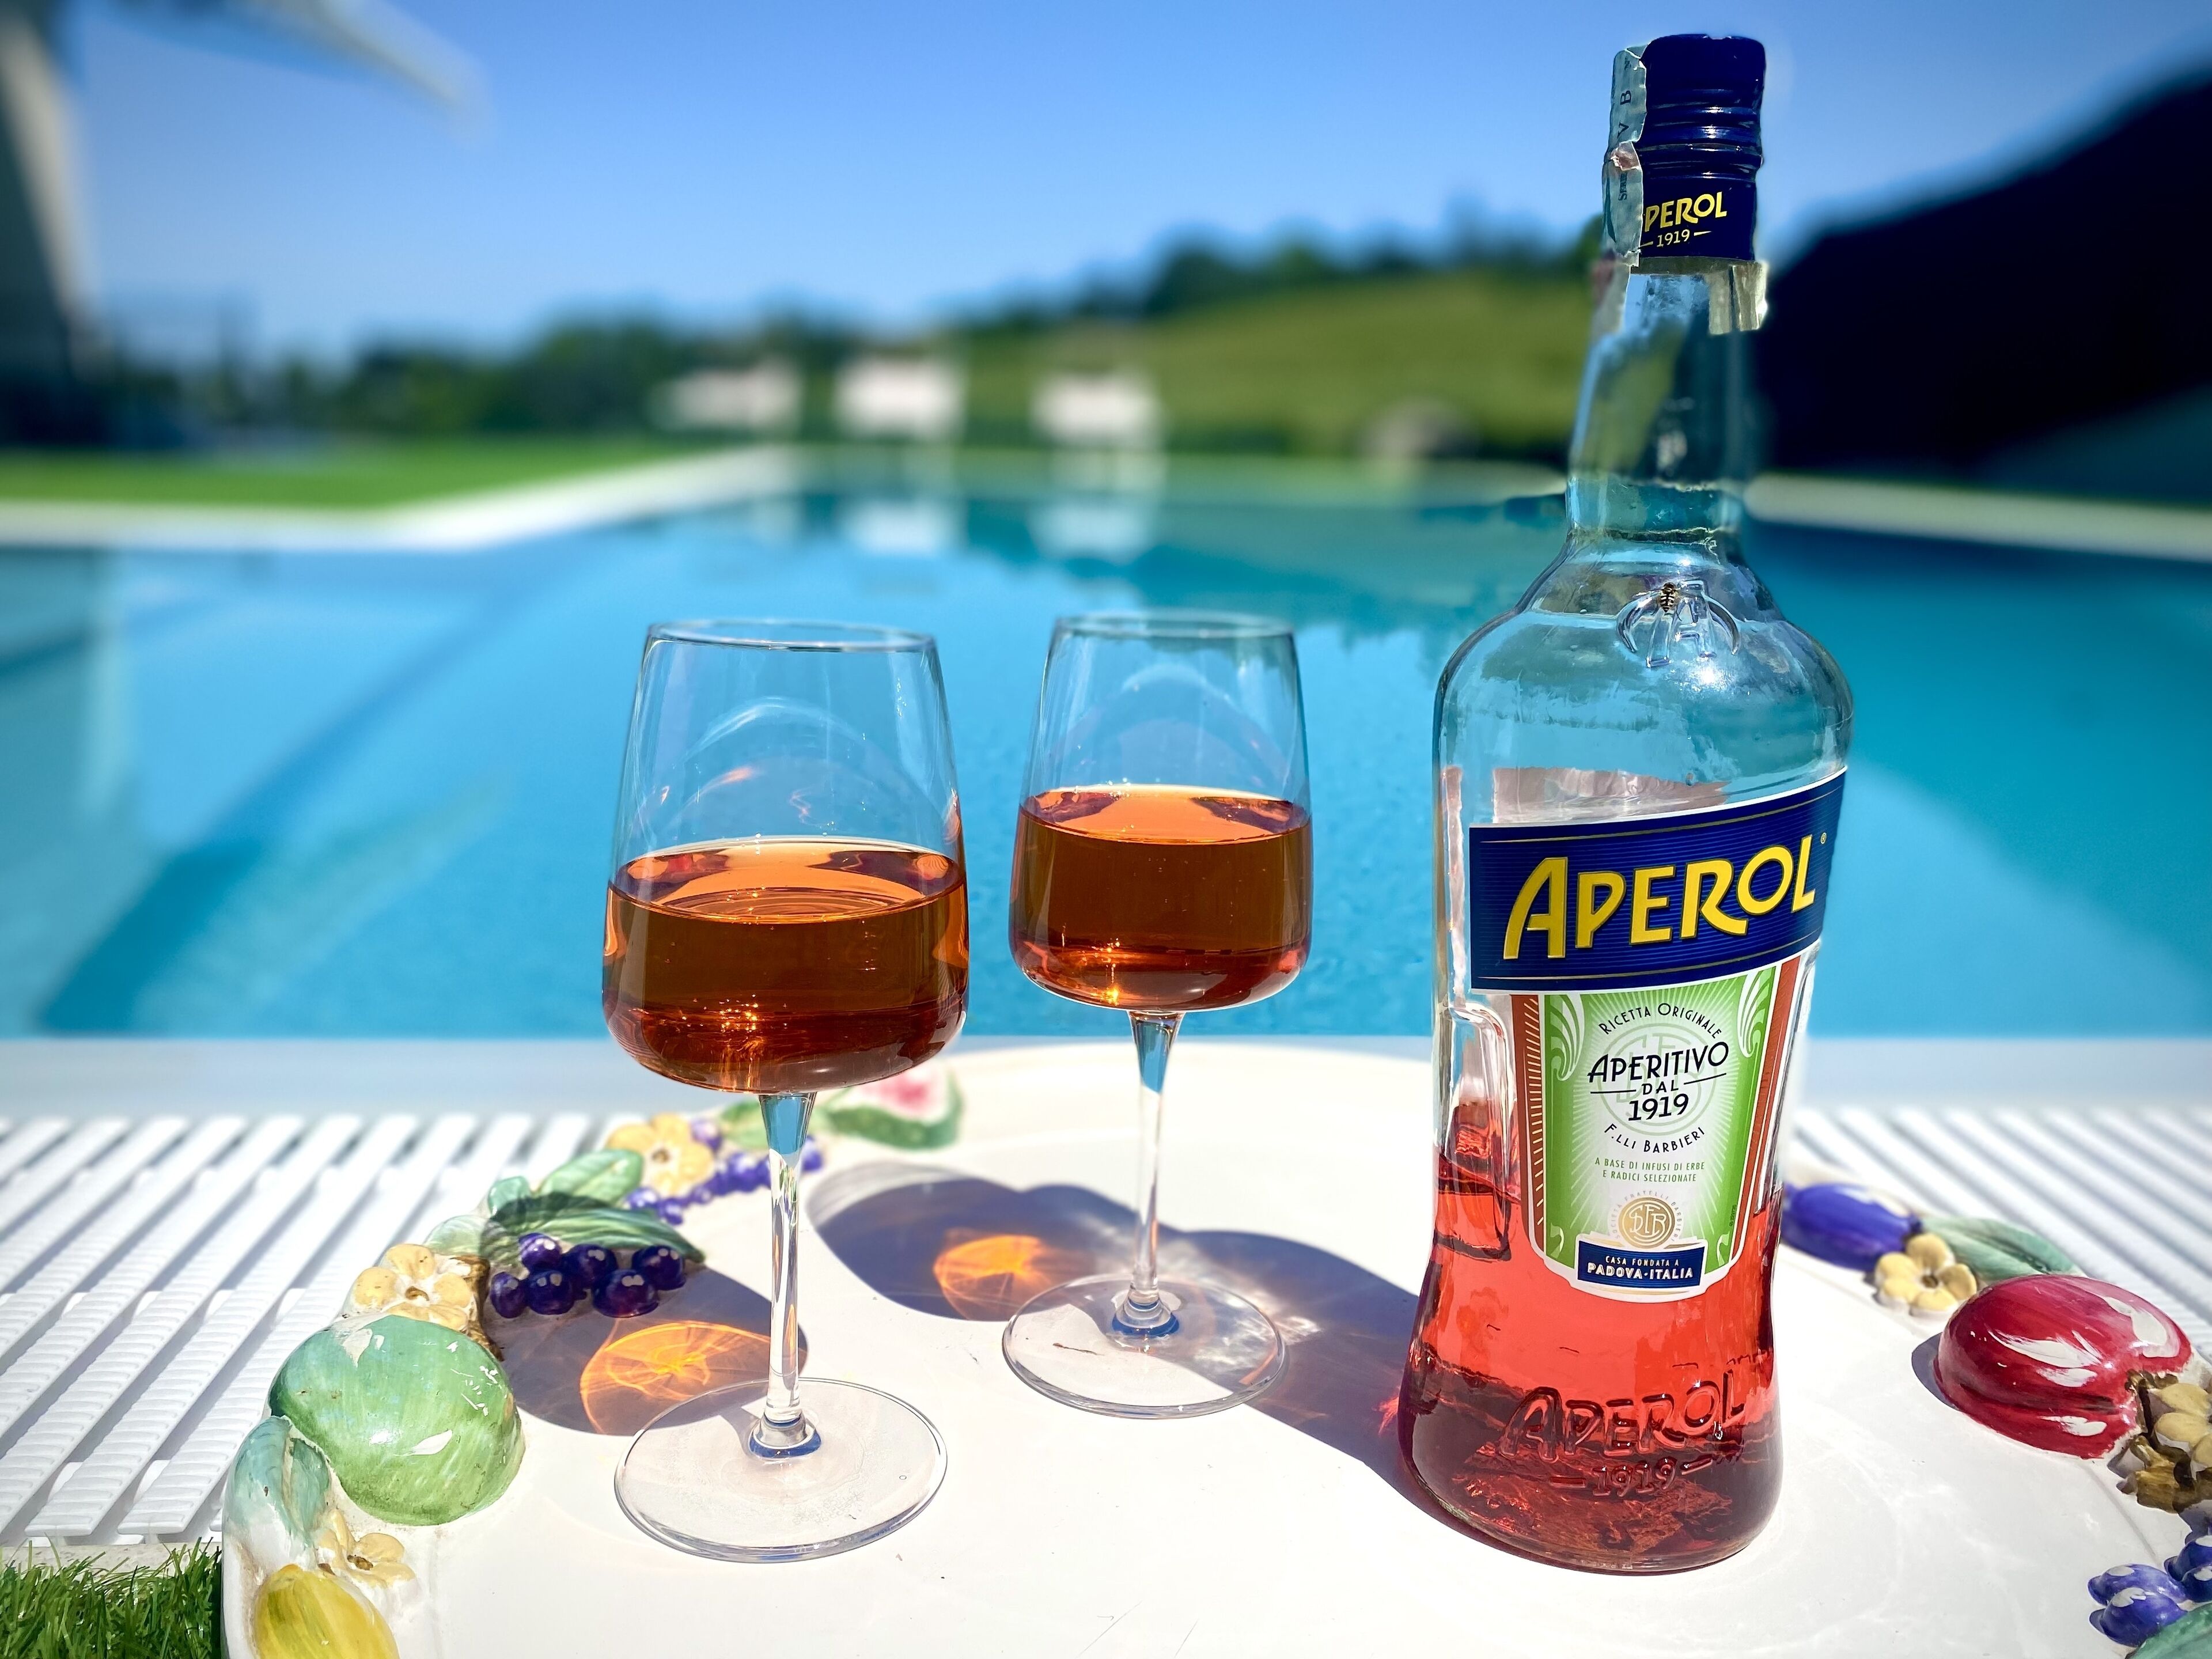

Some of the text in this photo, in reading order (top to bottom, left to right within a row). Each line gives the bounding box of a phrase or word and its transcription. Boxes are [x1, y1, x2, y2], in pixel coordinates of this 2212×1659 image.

[1644, 191, 1728, 233] PEROL
[1656, 229, 1690, 248] 1919
[1503, 834, 1816, 960] APEROL
[1598, 1002, 1722, 1039] RICETTA ORIGINALE
[1586, 1041, 1729, 1083] APERITIVO
[1641, 1079, 1679, 1096] DAL
[1627, 1093, 1690, 1122] 1919
[1604, 1123, 1705, 1153] F.LLI BARBIERI
[1594, 1157, 1705, 1171] A BASE DI INFUSI DI ERBE
[1603, 1169, 1697, 1183] E RADICI SELEZIONATE
[1605, 1255, 1679, 1267] CASA FONDATA A
[1499, 1369, 1746, 1463] APEROL
[1592, 1457, 1679, 1497] 1919
